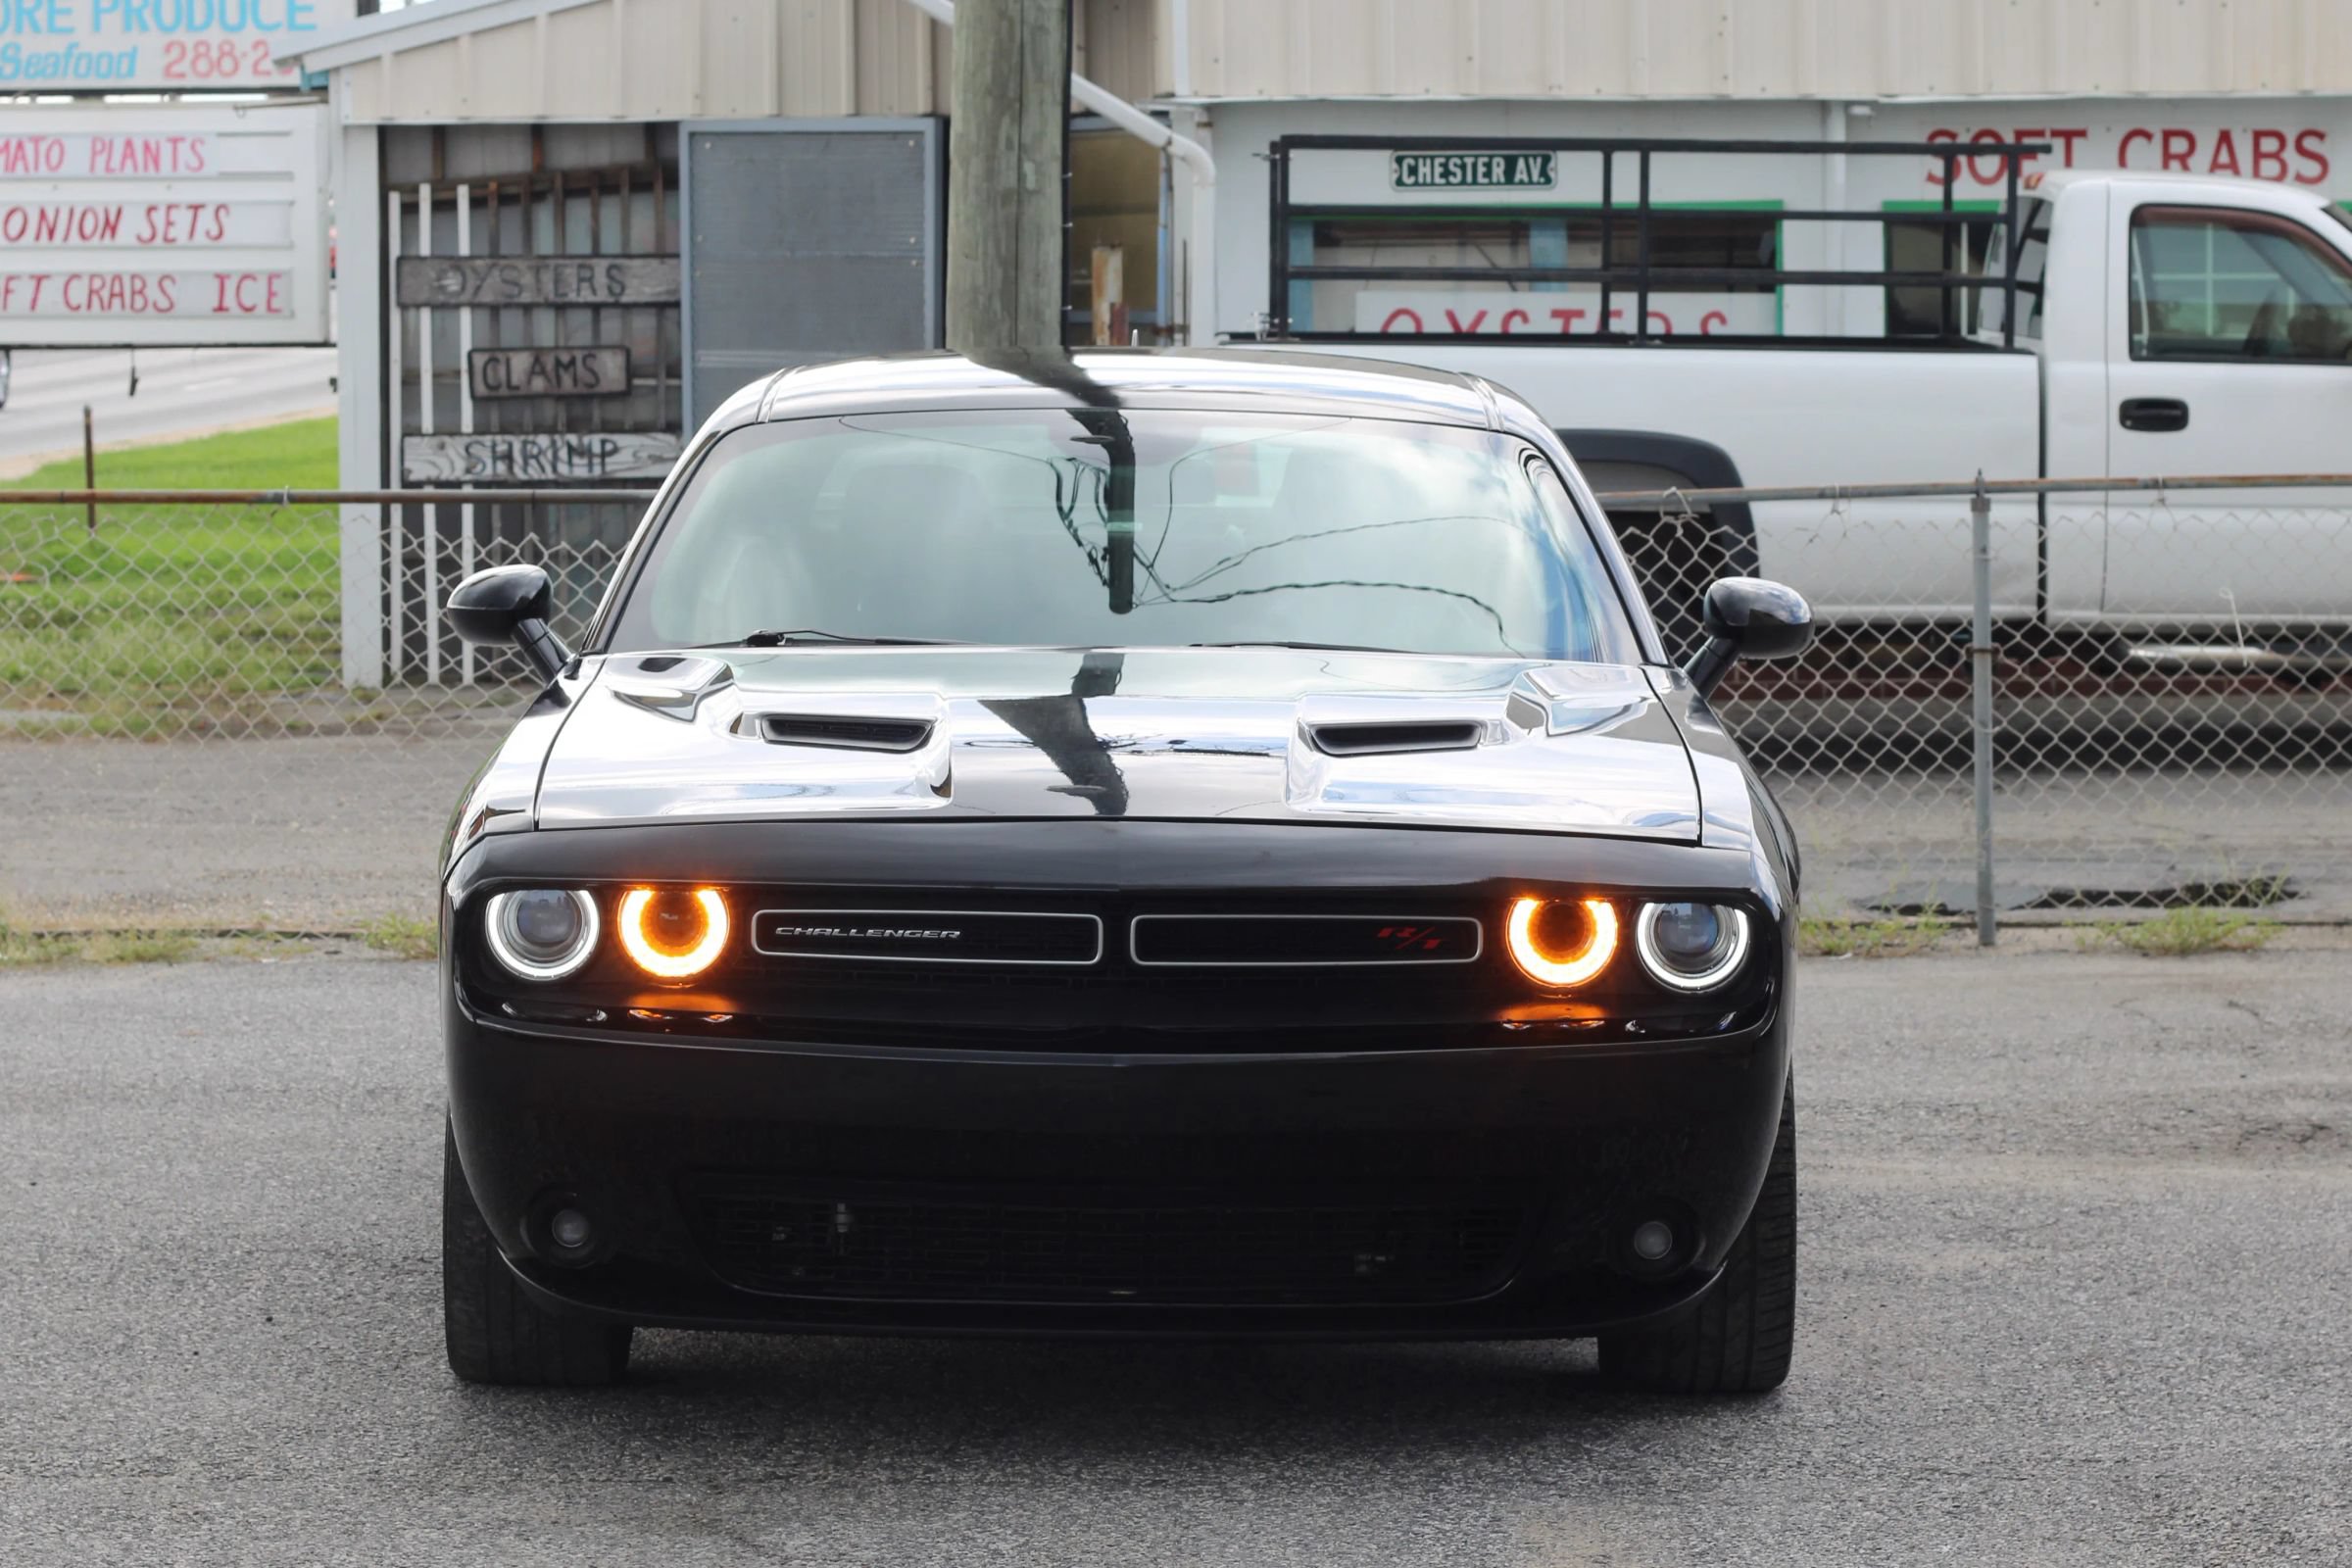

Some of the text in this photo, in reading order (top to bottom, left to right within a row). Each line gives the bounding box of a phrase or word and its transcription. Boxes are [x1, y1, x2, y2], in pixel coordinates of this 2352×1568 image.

[93, 0, 318, 32] PRODUCE
[0, 39, 298, 79] Seafood 288-2
[89, 136, 205, 173] PLANTS
[1401, 156, 1545, 184] CHESTER AV.
[2118, 128, 2331, 185] CRABS
[3, 203, 230, 244] ONION SETS
[64, 273, 176, 314] CRABS
[213, 273, 283, 314] ICE
[435, 262, 626, 299] OYSTERS
[481, 353, 601, 391] CLAMS
[465, 438, 619, 475] SHRIMP
[774, 926, 961, 940] CHALLENGER
[1377, 925, 1444, 951] R/T
